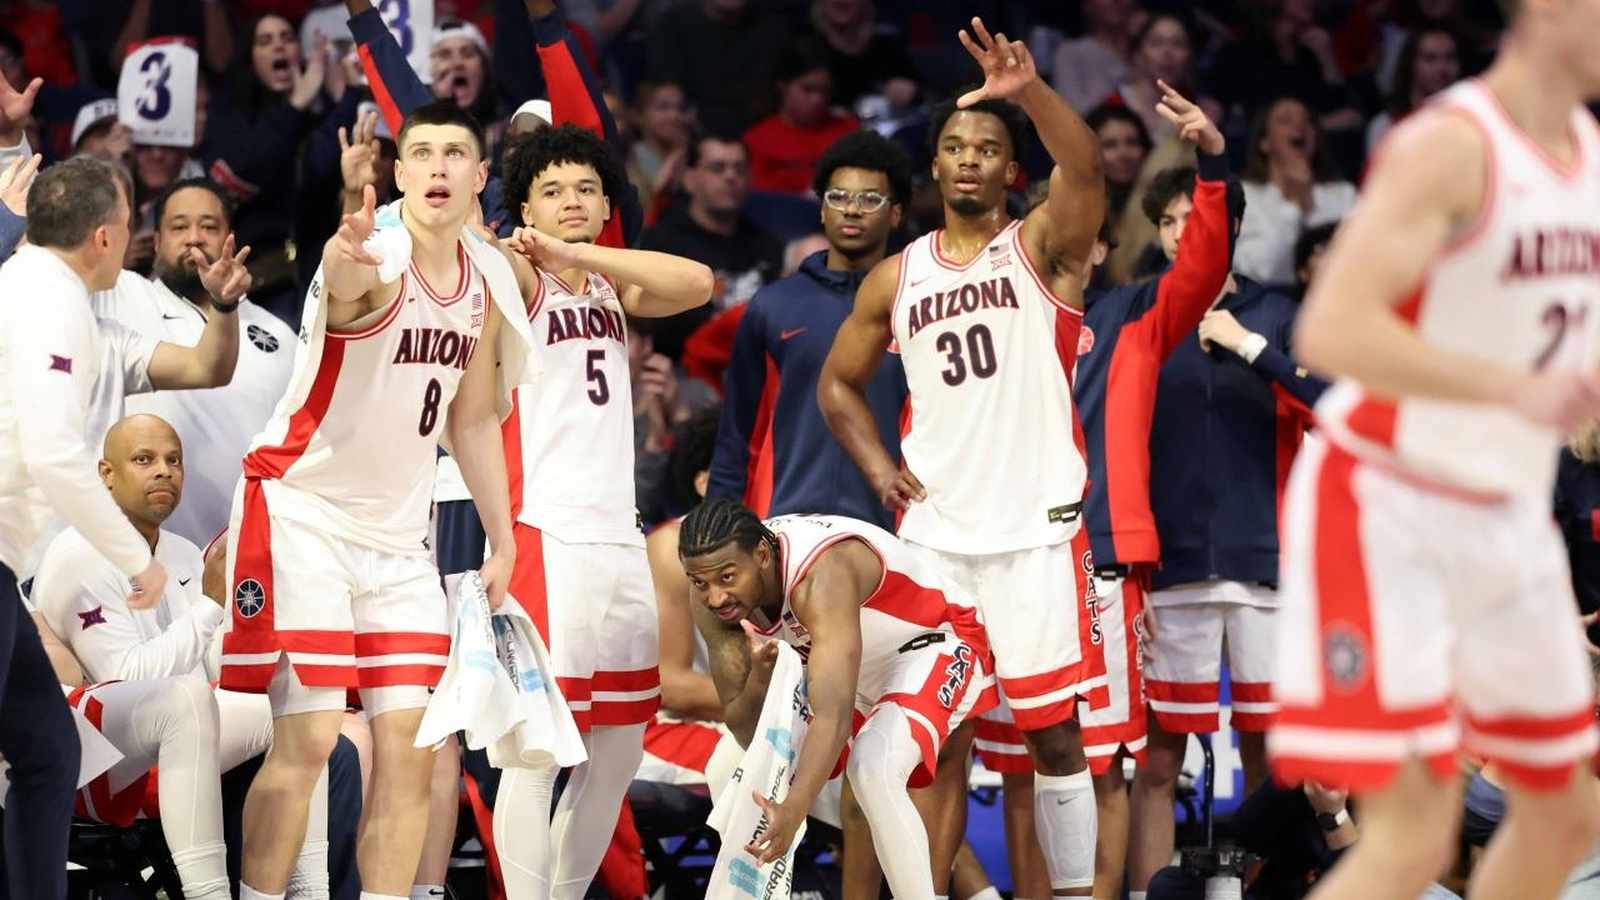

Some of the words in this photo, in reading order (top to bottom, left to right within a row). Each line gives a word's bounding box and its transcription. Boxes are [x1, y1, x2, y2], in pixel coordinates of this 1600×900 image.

[136, 52, 171, 121] 3
[908, 276, 1020, 340] ARIZONA
[586, 349, 610, 406] 5
[936, 323, 997, 387] 30
[418, 377, 442, 437] 8
[1082, 550, 1103, 645] CATS
[937, 644, 972, 708] CATS
